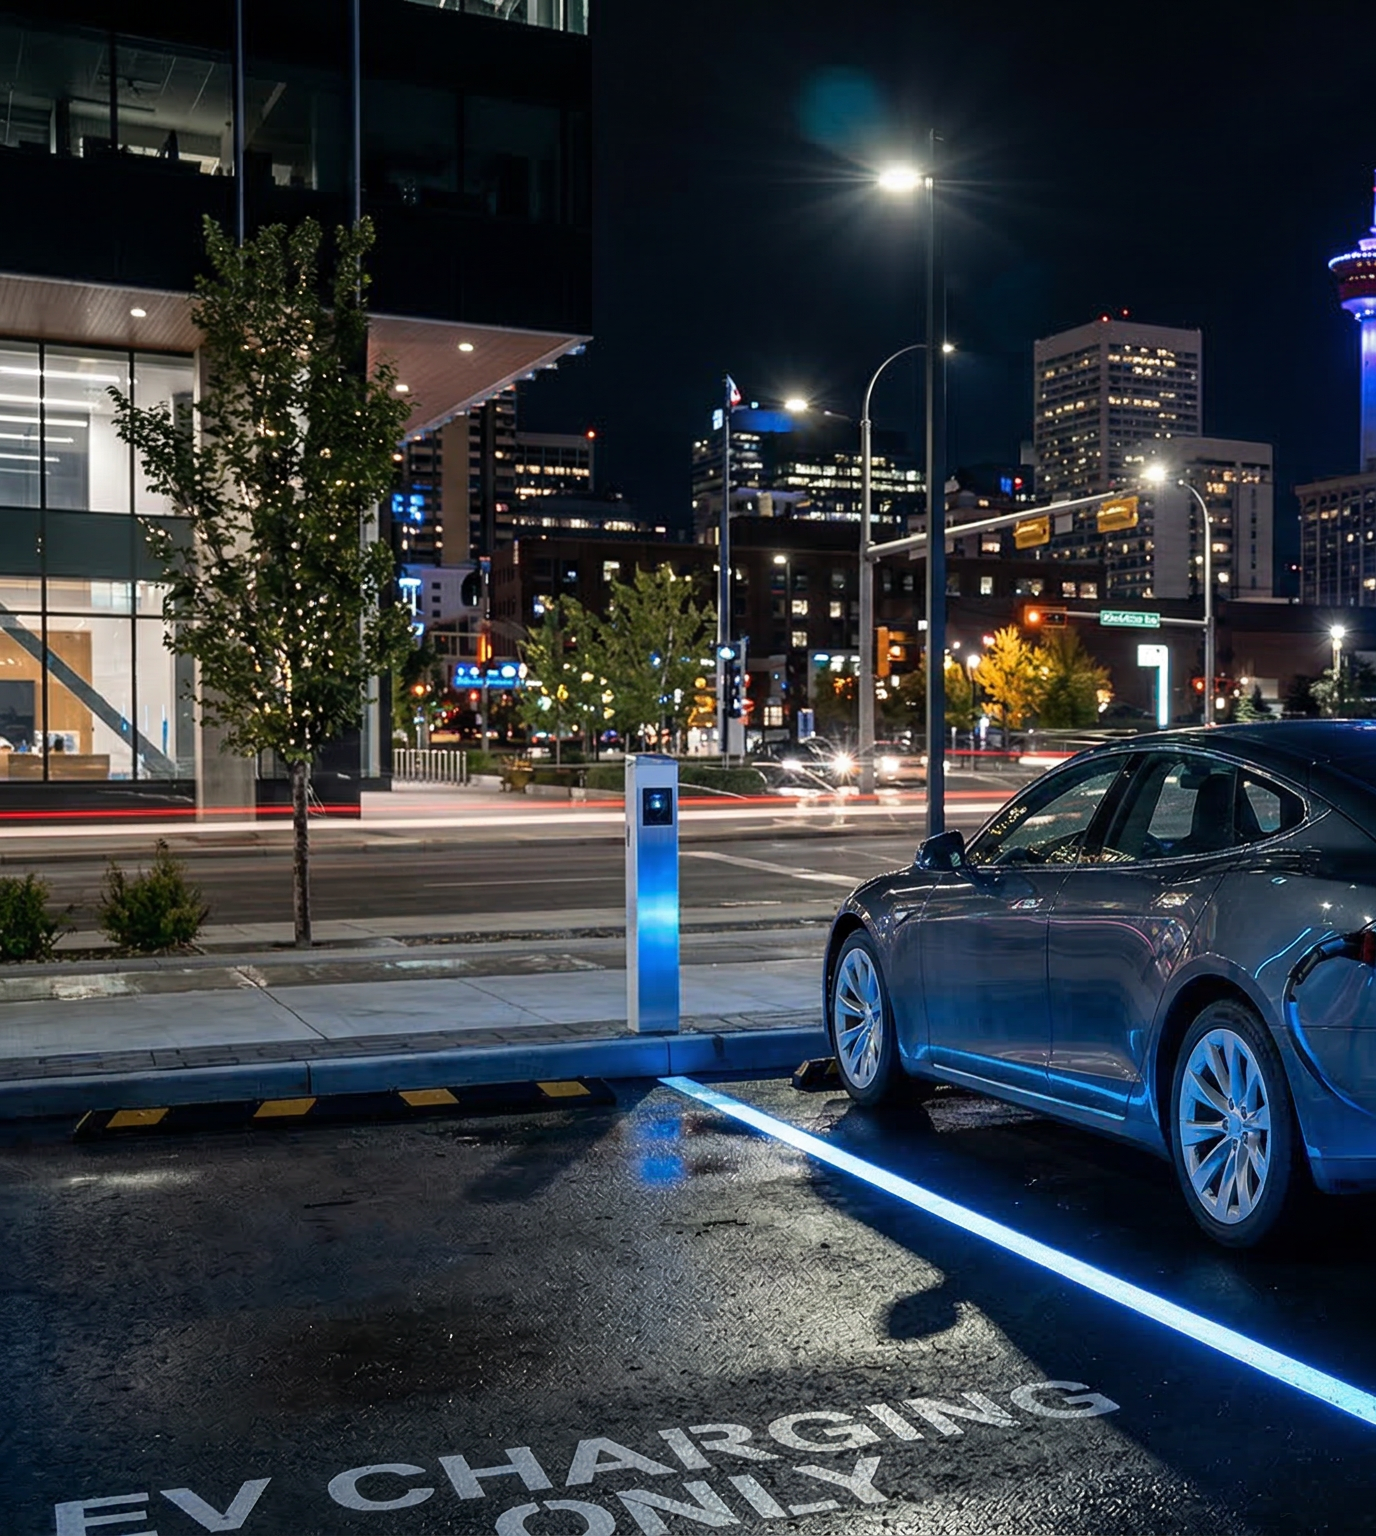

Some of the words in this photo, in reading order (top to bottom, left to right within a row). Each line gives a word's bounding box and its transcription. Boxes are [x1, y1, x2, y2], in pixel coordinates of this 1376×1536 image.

[54, 1477, 272, 1536] EV
[327, 1380, 1121, 1511] CHARGING
[494, 1456, 890, 1536] ONLY
